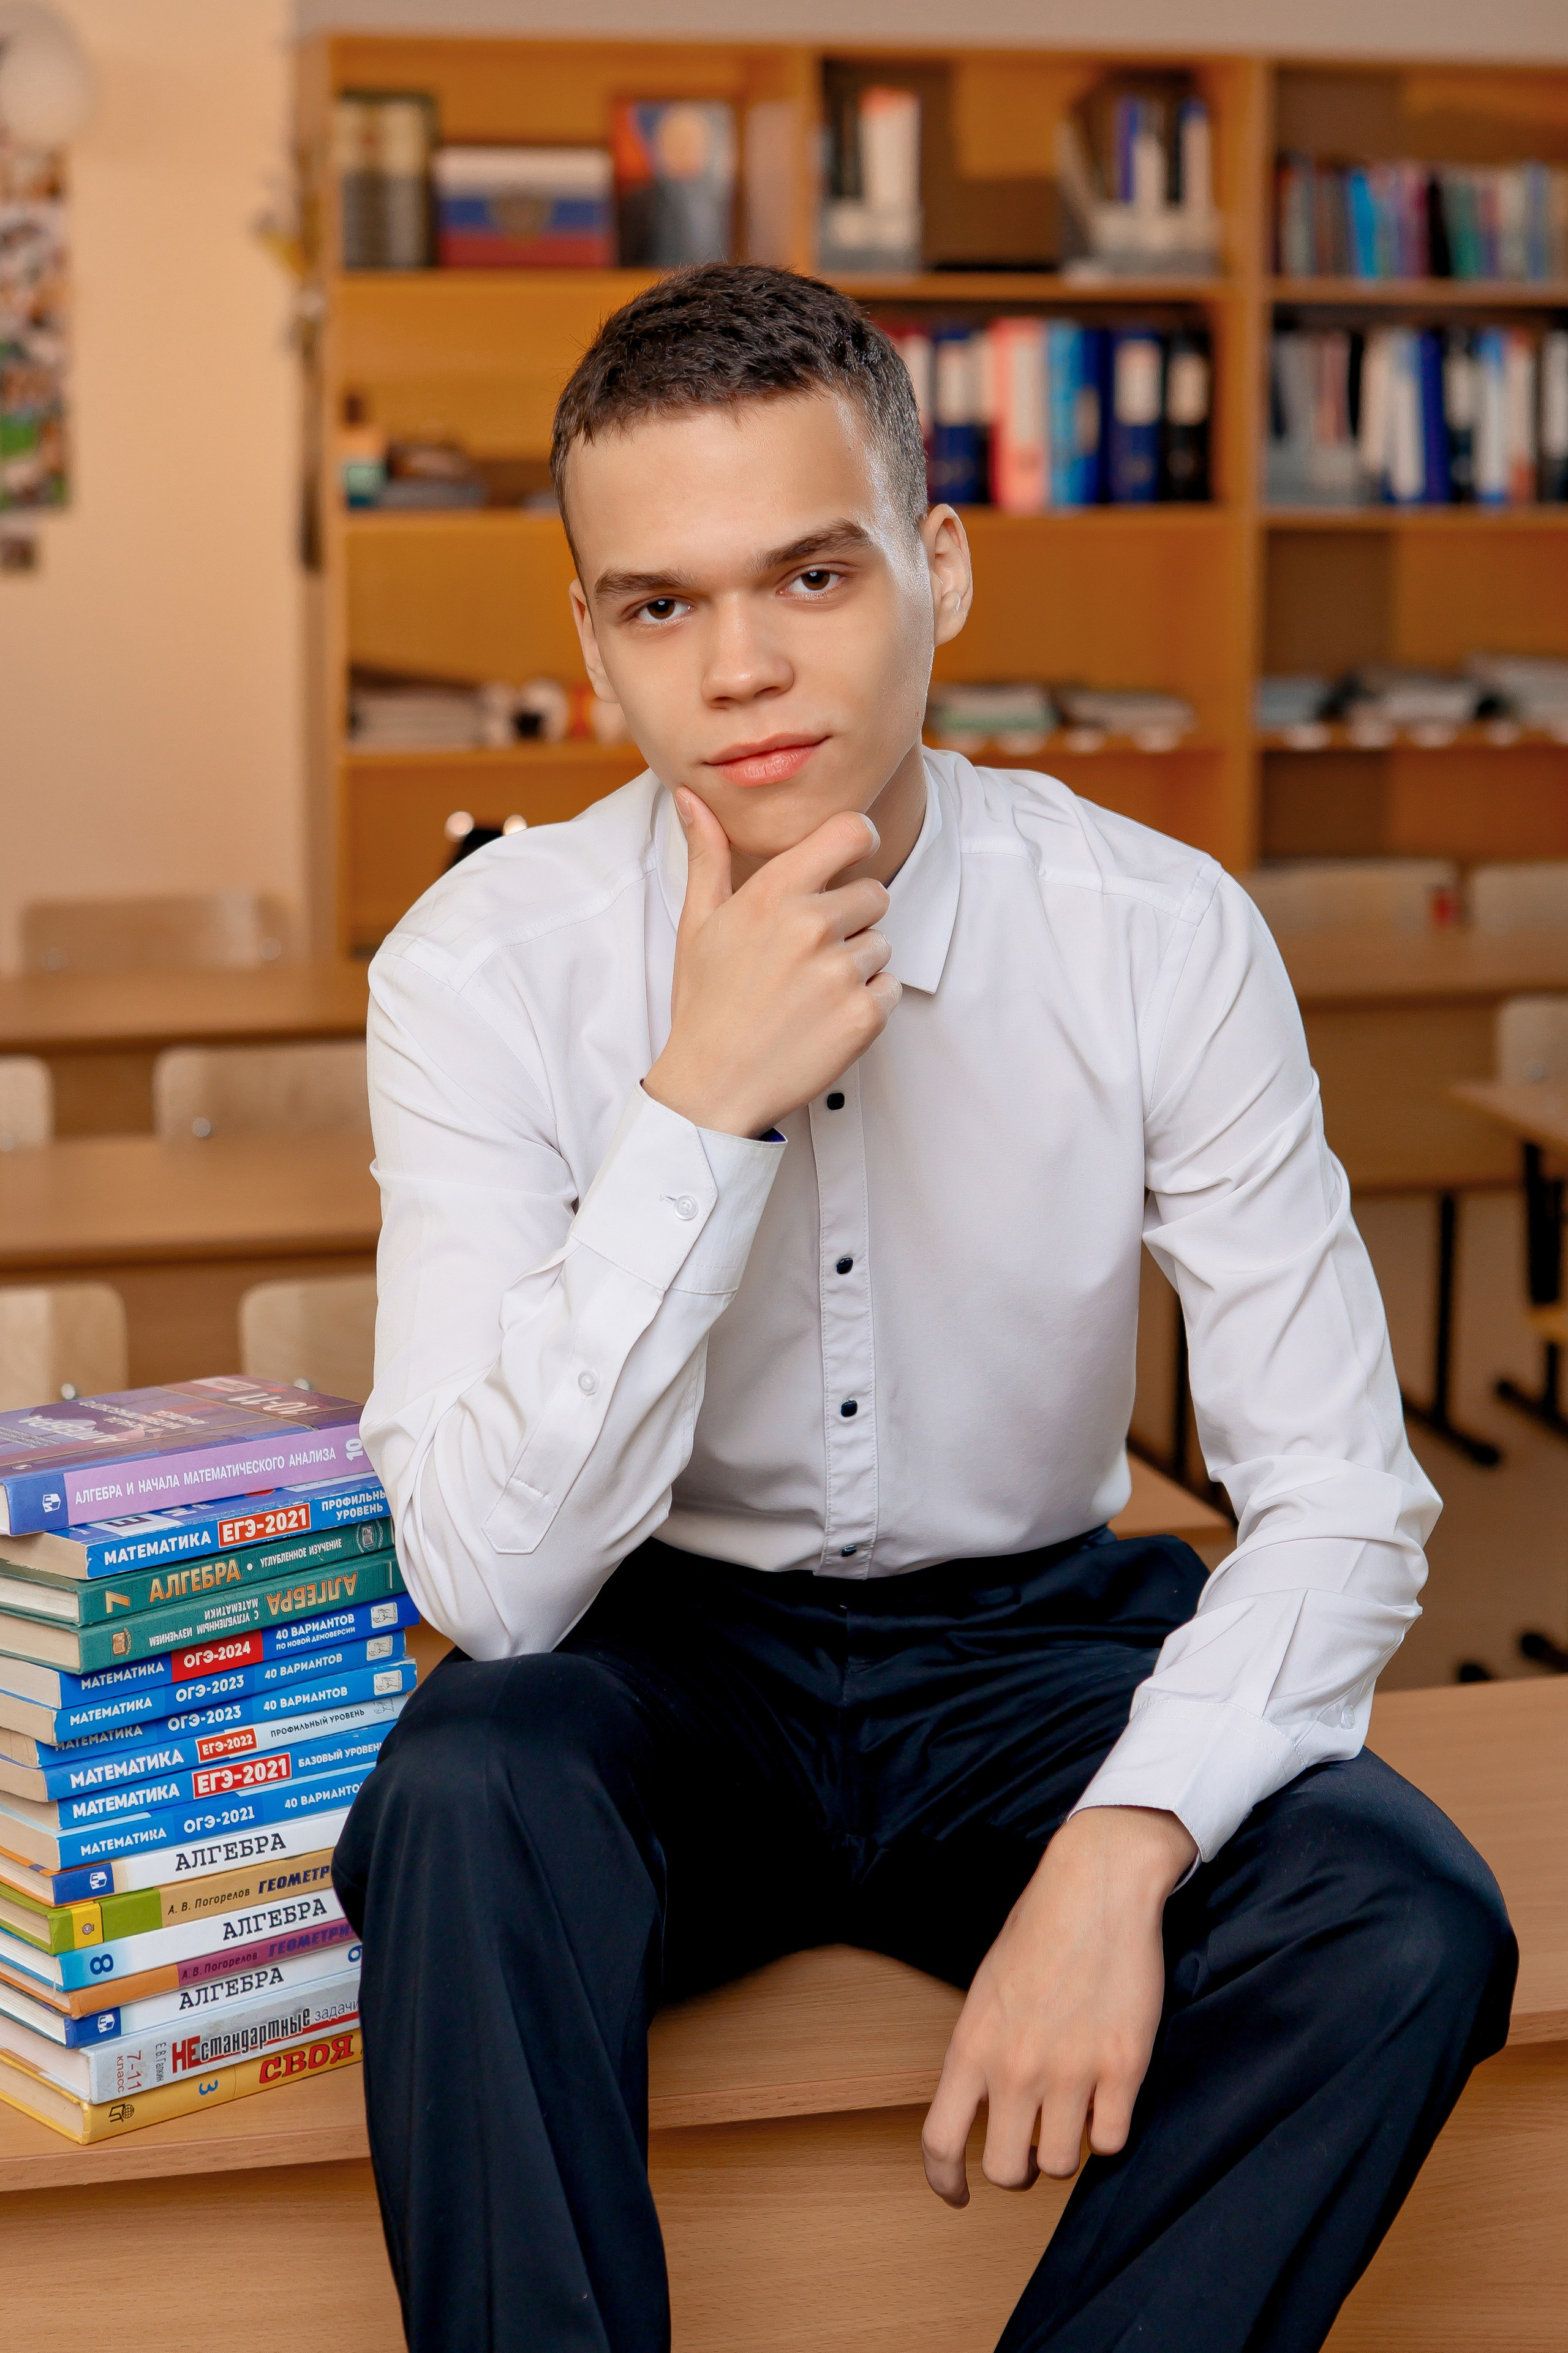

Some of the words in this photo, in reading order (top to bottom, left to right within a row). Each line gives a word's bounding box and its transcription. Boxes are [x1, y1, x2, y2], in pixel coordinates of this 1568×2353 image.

[345, 1438, 364, 1462] 10
[75, 1484, 123, 1505] АЛГЕБРА
[126, 1481, 135, 1495] И
[138, 1474, 180, 1494] НАЧАЛА
[184, 1455, 285, 1486] МАТЕМАТИЧЕСКОГО
[289, 1447, 336, 1467] АНАЛИЗА
[336, 1503, 383, 1521] УРОВЕНЬ
[104, 1530, 212, 1566] МАТЕМАТИКА
[222, 1508, 307, 1543] ЕГЭ-2021
[105, 1590, 130, 1614] 7
[149, 1558, 241, 1603] АЛГЕБРА
[260, 1546, 307, 1568] УГЛУБЛЕННОЕ
[309, 1538, 342, 1555] ИЗУЧЕНИЕ
[266, 1573, 358, 1616] АЛГЕБРА
[197, 1612, 251, 1635] УГЛУБЛЕННЫМ
[204, 1598, 259, 1621] МАТЕМАТИКИ
[254, 1610, 260, 1620] С
[276, 1629, 288, 1641] 40
[291, 1613, 355, 1639] ВАРИАНТОВ
[149, 1626, 193, 1648] ИЗУЧЕНИЕМ
[287, 1635, 311, 1649] НОВОЙ
[311, 1626, 355, 1643] ДЕМОВЕРСИИ
[81, 1661, 164, 1691] МАТЕМАТИКА
[184, 1641, 251, 1669] ОГЭ-2024
[70, 1696, 153, 1726] МАТЕМАТИКА
[175, 1674, 244, 1703] ОГЭ-2023
[265, 1668, 277, 1680] 40
[280, 1653, 343, 1677] ВАРИАНТОВ
[55, 1724, 143, 1752] МАТЕМАТИКА
[168, 1705, 242, 1732] ОГЭ-2023
[263, 1699, 277, 1711] 40
[280, 1686, 348, 1710] ВАРИАНТОВ
[70, 1748, 184, 1789] МАТЕМАТИКА
[202, 1734, 254, 1756] ЕГЭ-2022
[271, 1717, 328, 1738] ПРОФИЛЬНЫЙ
[330, 1709, 365, 1723] УРОВЕНЬ
[72, 1783, 180, 1819] МАТЕМАТИКА
[197, 1758, 288, 1794] ЕГЭ-2021
[298, 1748, 343, 1769] БАЗОВЫЙ
[80, 1827, 167, 1857] МАТЕМАТИКА
[184, 1805, 255, 1834] ОГЭ-2021
[284, 1797, 298, 1810] 40
[301, 1781, 363, 1805] ВАРИАНТО
[175, 1832, 287, 1871] АЛГЕБРА
[168, 1905, 178, 1916] А.
[181, 1902, 190, 1911] В.
[195, 1888, 250, 1909] Погорелов
[258, 1865, 331, 1895] ГЕОМЕТР
[89, 1954, 114, 1975] 8
[223, 1898, 328, 1941] АЛГЕБРА
[181, 1970, 190, 1980] А.
[193, 1966, 202, 1976] В.
[205, 1952, 258, 1973] Погорелов
[179, 1966, 284, 2010] АЛГЕБРА
[116, 2055, 125, 2094] класс
[127, 2050, 143, 2090] 7-11
[259, 2034, 354, 2084] СВОЯ
